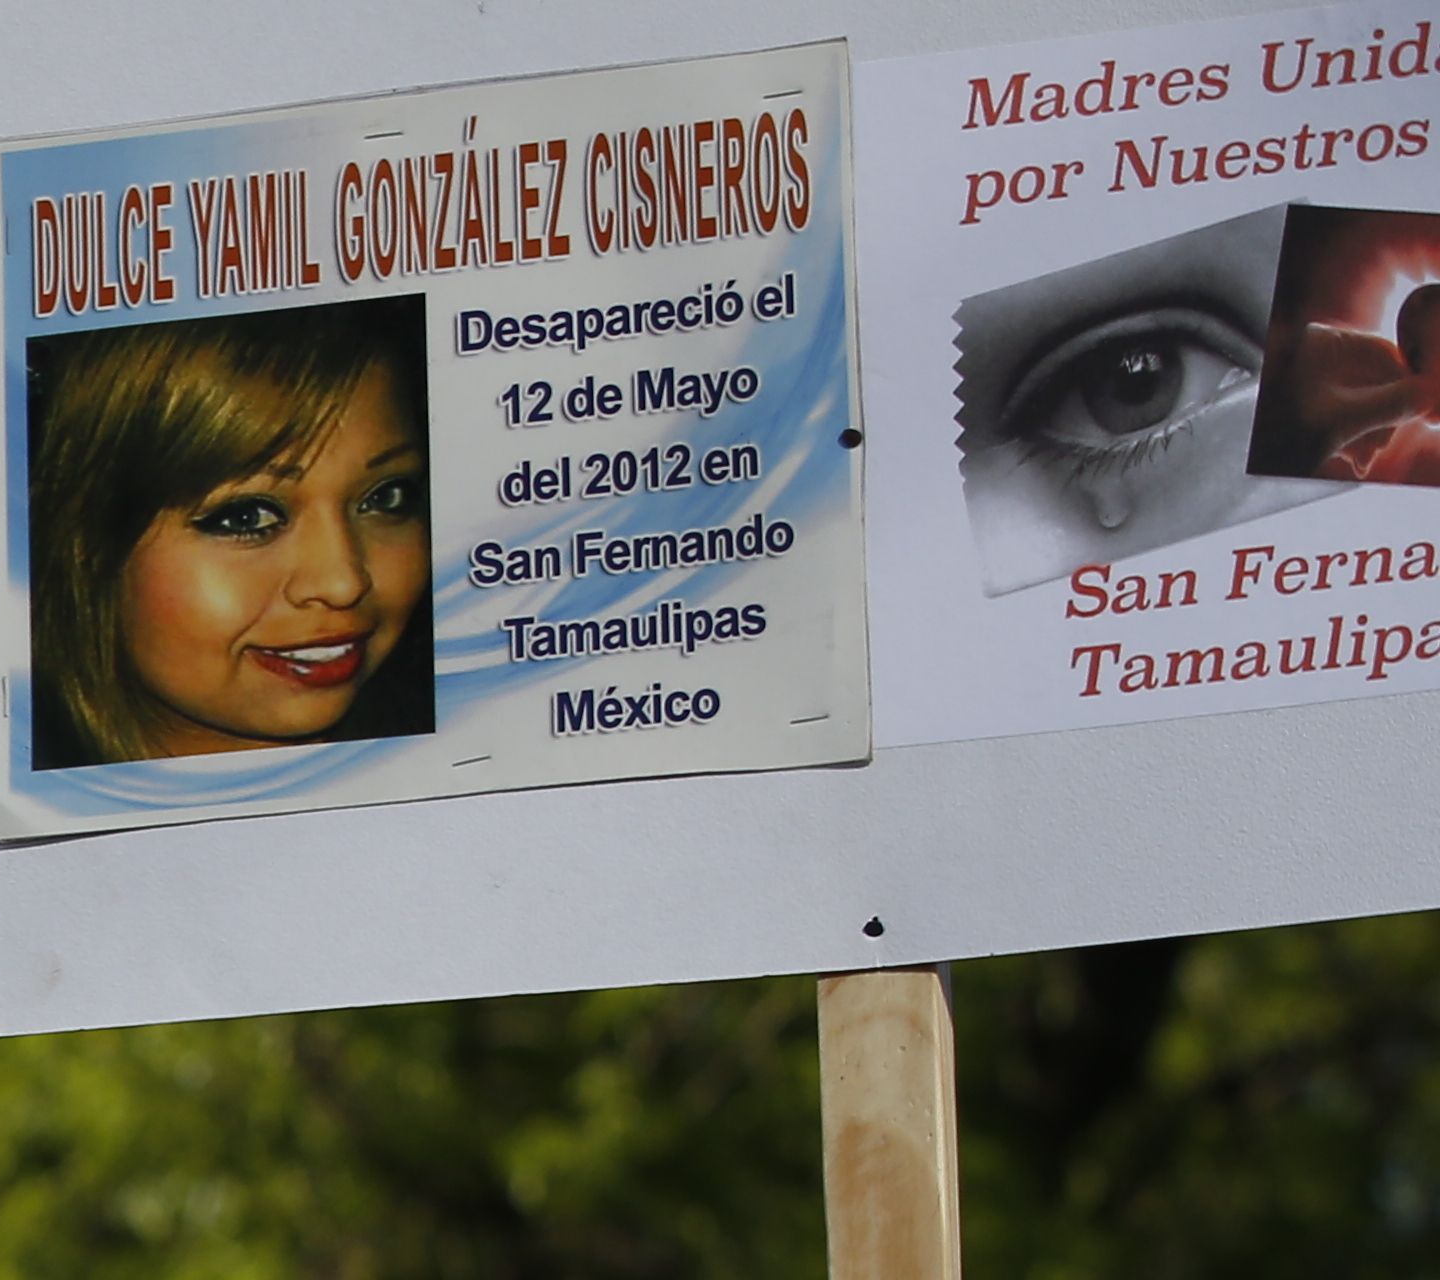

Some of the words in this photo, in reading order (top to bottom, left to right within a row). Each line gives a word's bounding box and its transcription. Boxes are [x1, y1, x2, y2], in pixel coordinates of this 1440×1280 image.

[961, 60, 1231, 130] Madres
[1261, 21, 1440, 94] Unid
[959, 158, 1084, 225] por
[1108, 117, 1430, 193] Nuestros
[34, 184, 175, 316] DULCE
[190, 167, 320, 298] YAMIL
[335, 115, 572, 283] GONZÁLEZ
[586, 107, 813, 256] CISNEROS
[458, 281, 745, 353] Desapareció
[755, 274, 797, 320] el
[501, 381, 555, 427] 12
[565, 373, 623, 418] de
[633, 366, 761, 421] Mayo
[502, 455, 571, 503] del
[583, 445, 692, 494] 2012
[701, 440, 760, 487] en
[470, 538, 561, 586] San
[575, 514, 796, 576] Fernando
[1065, 562, 1199, 620] San
[504, 599, 768, 662] Tamaulipas
[552, 681, 722, 734] México
